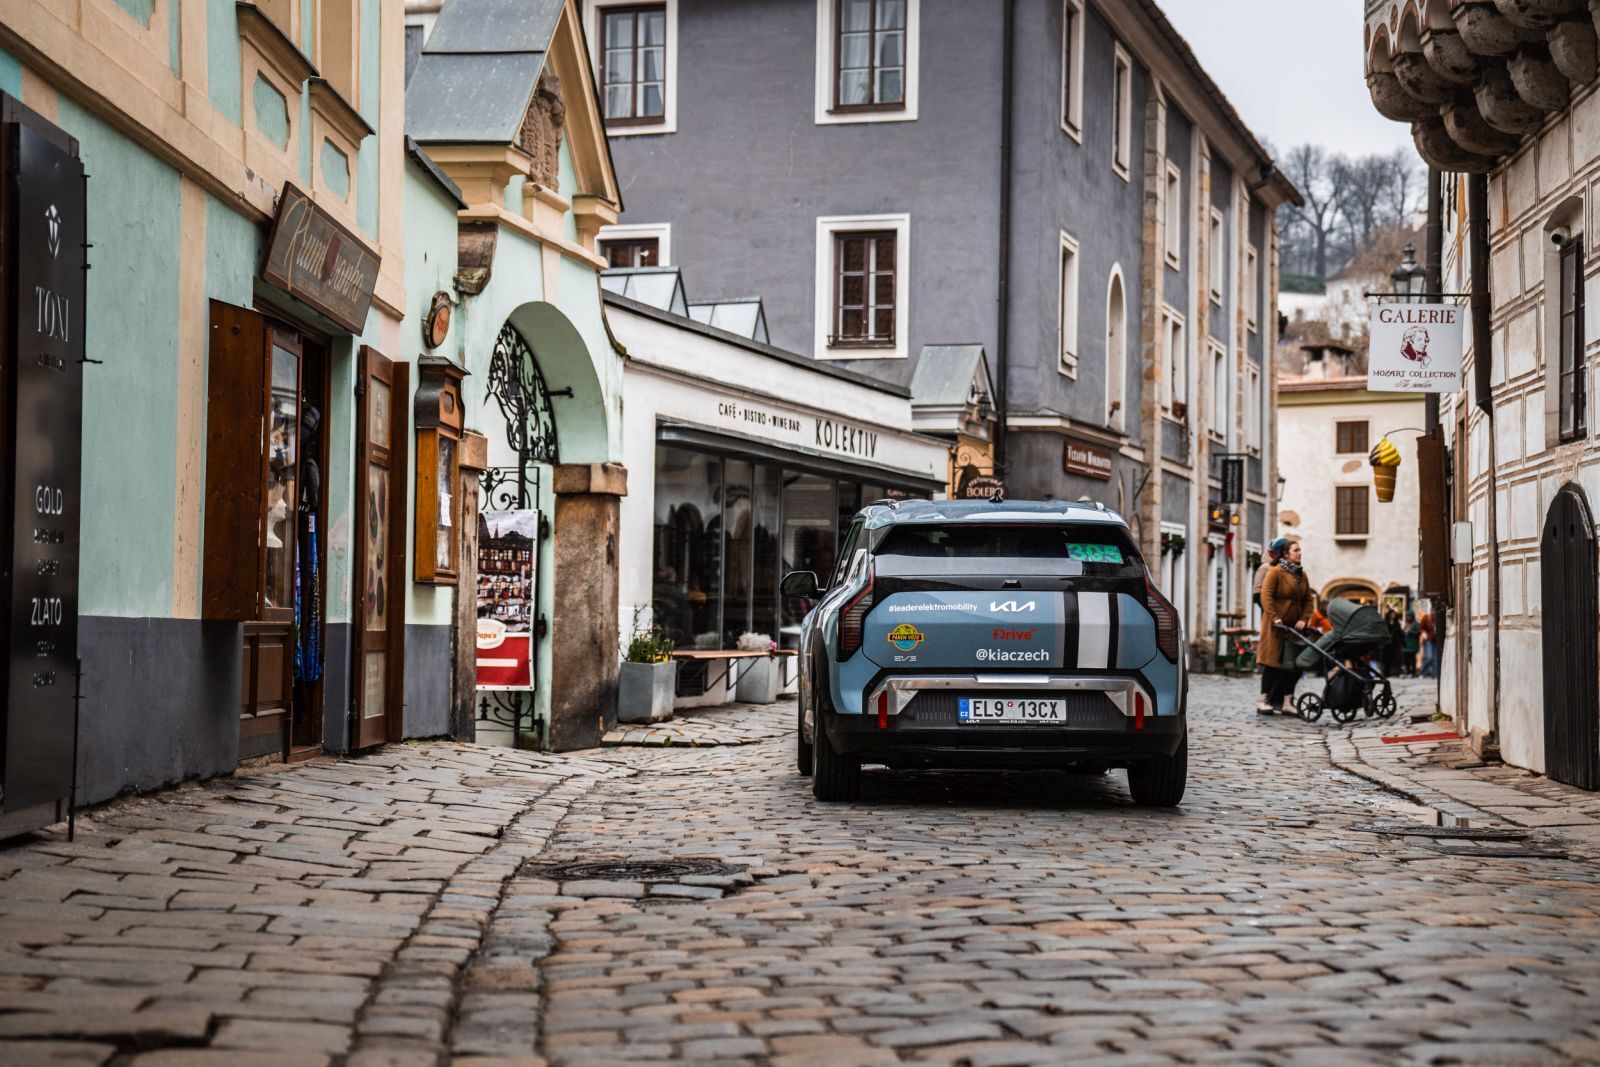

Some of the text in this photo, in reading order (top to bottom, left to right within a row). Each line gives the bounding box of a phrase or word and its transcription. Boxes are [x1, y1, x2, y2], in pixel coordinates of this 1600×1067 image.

[36, 286, 69, 342] TONI
[1380, 308, 1456, 324] GALERIE
[1373, 370, 1456, 378] MOZART COLLECTION
[718, 403, 800, 432] CAFÉ BISTRO WINE BAR
[815, 418, 877, 458] KOLEKTIV
[36, 485, 63, 515] GOLD
[1069, 543, 1121, 563] 305
[31, 598, 62, 625] ZLATO
[889, 603, 978, 612] #leaderelektromobility
[976, 649, 1049, 661] @kiaczech
[973, 701, 1058, 719] EL9 13CX
